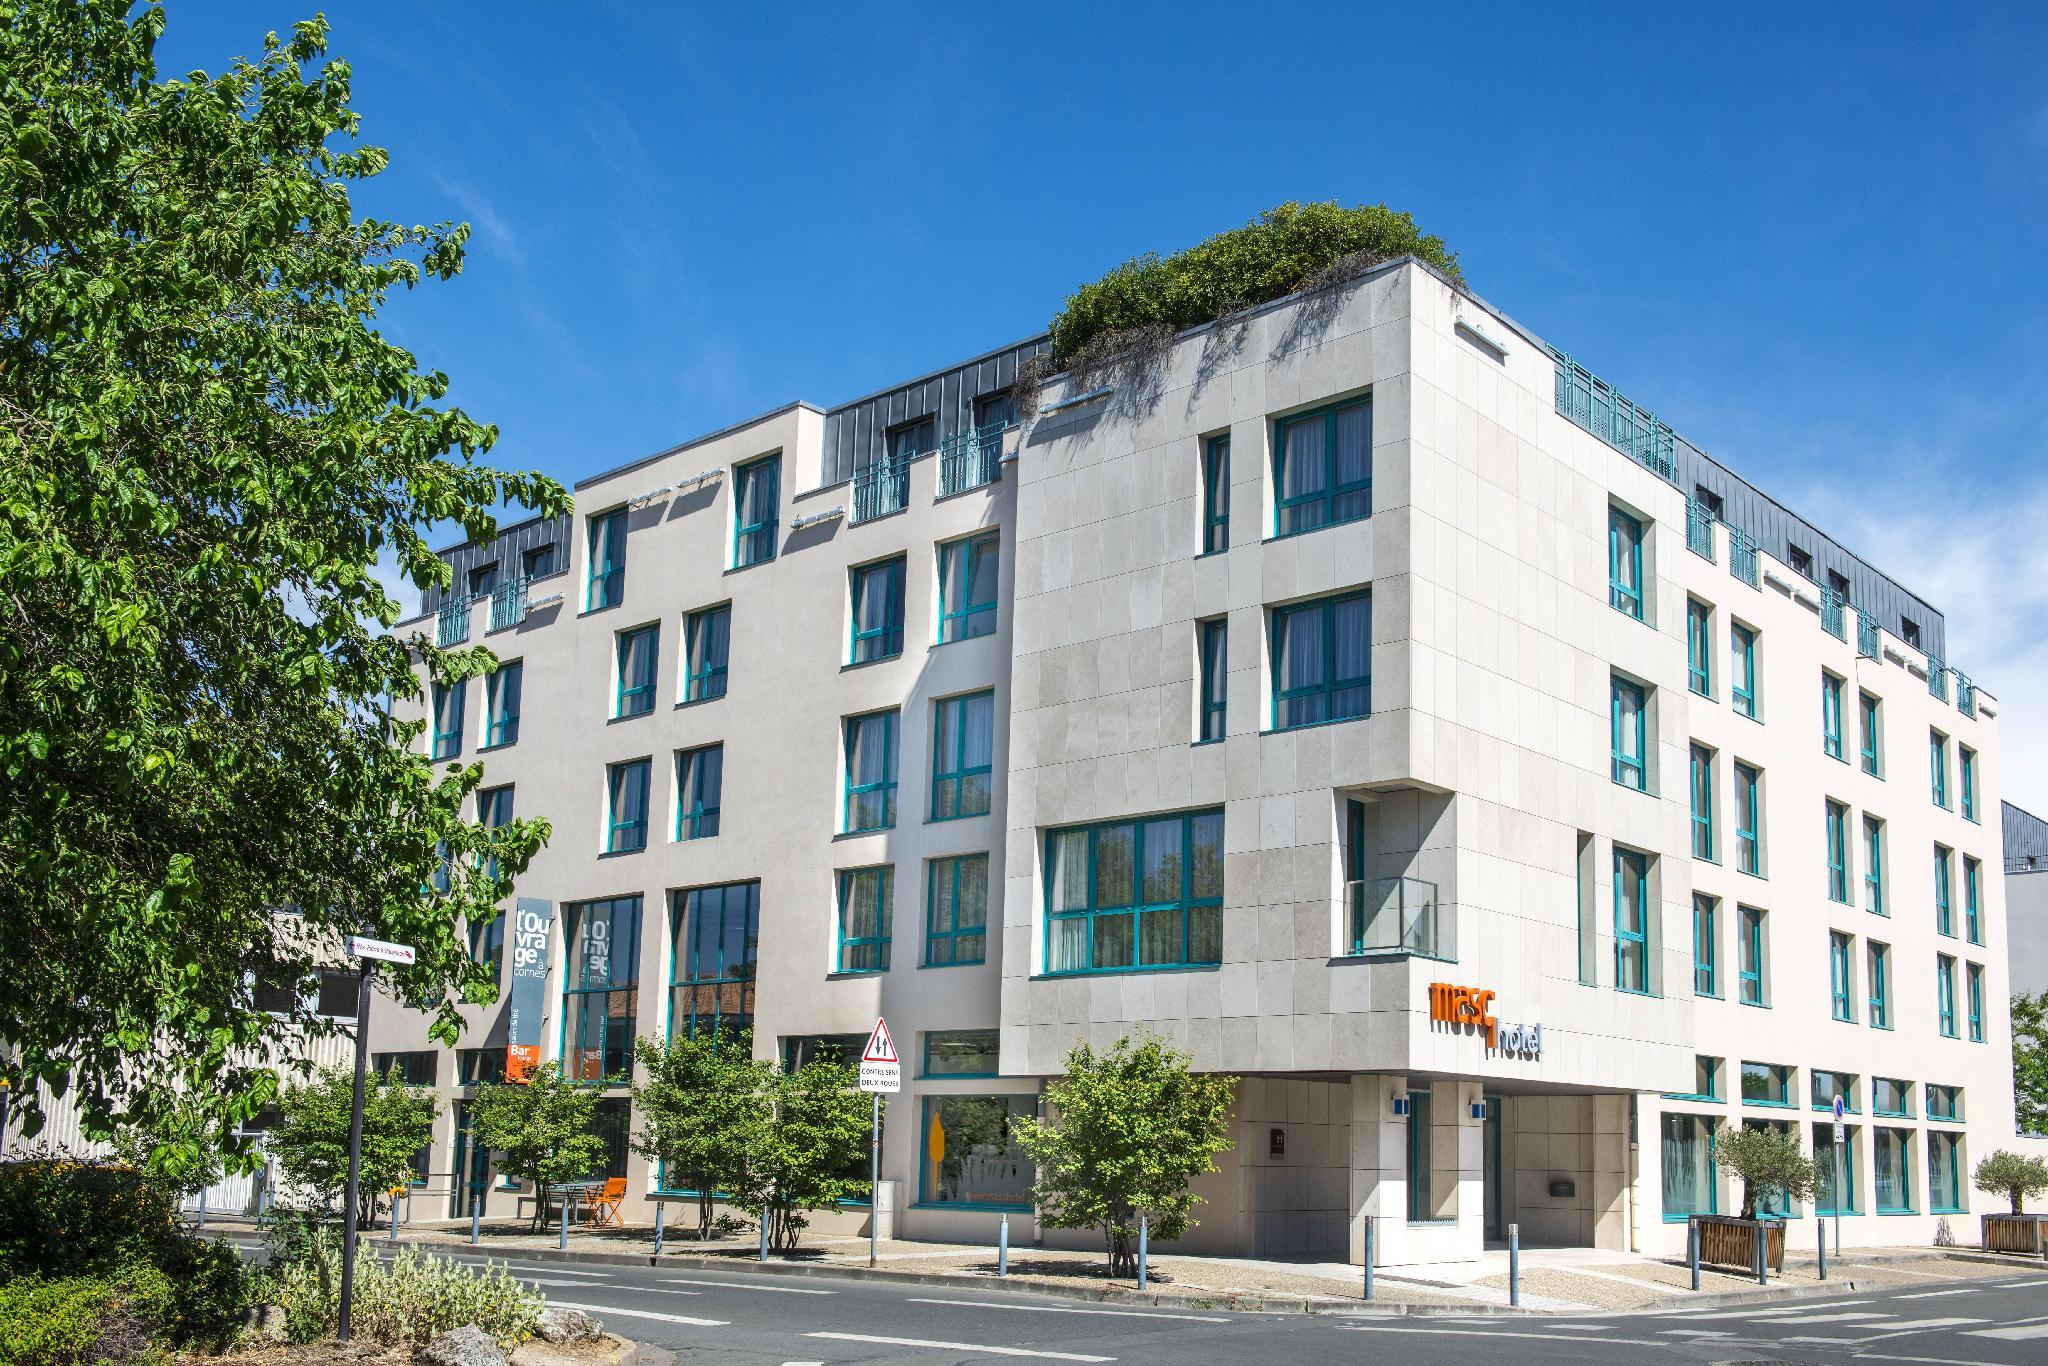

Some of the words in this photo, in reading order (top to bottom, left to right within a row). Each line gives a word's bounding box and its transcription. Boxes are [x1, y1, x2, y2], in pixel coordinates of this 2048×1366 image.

[516, 932, 546, 949] vra
[514, 946, 538, 968] ge
[513, 968, 546, 979] cornes
[1494, 1017, 1543, 1054] hotel
[511, 1044, 530, 1056] Bar
